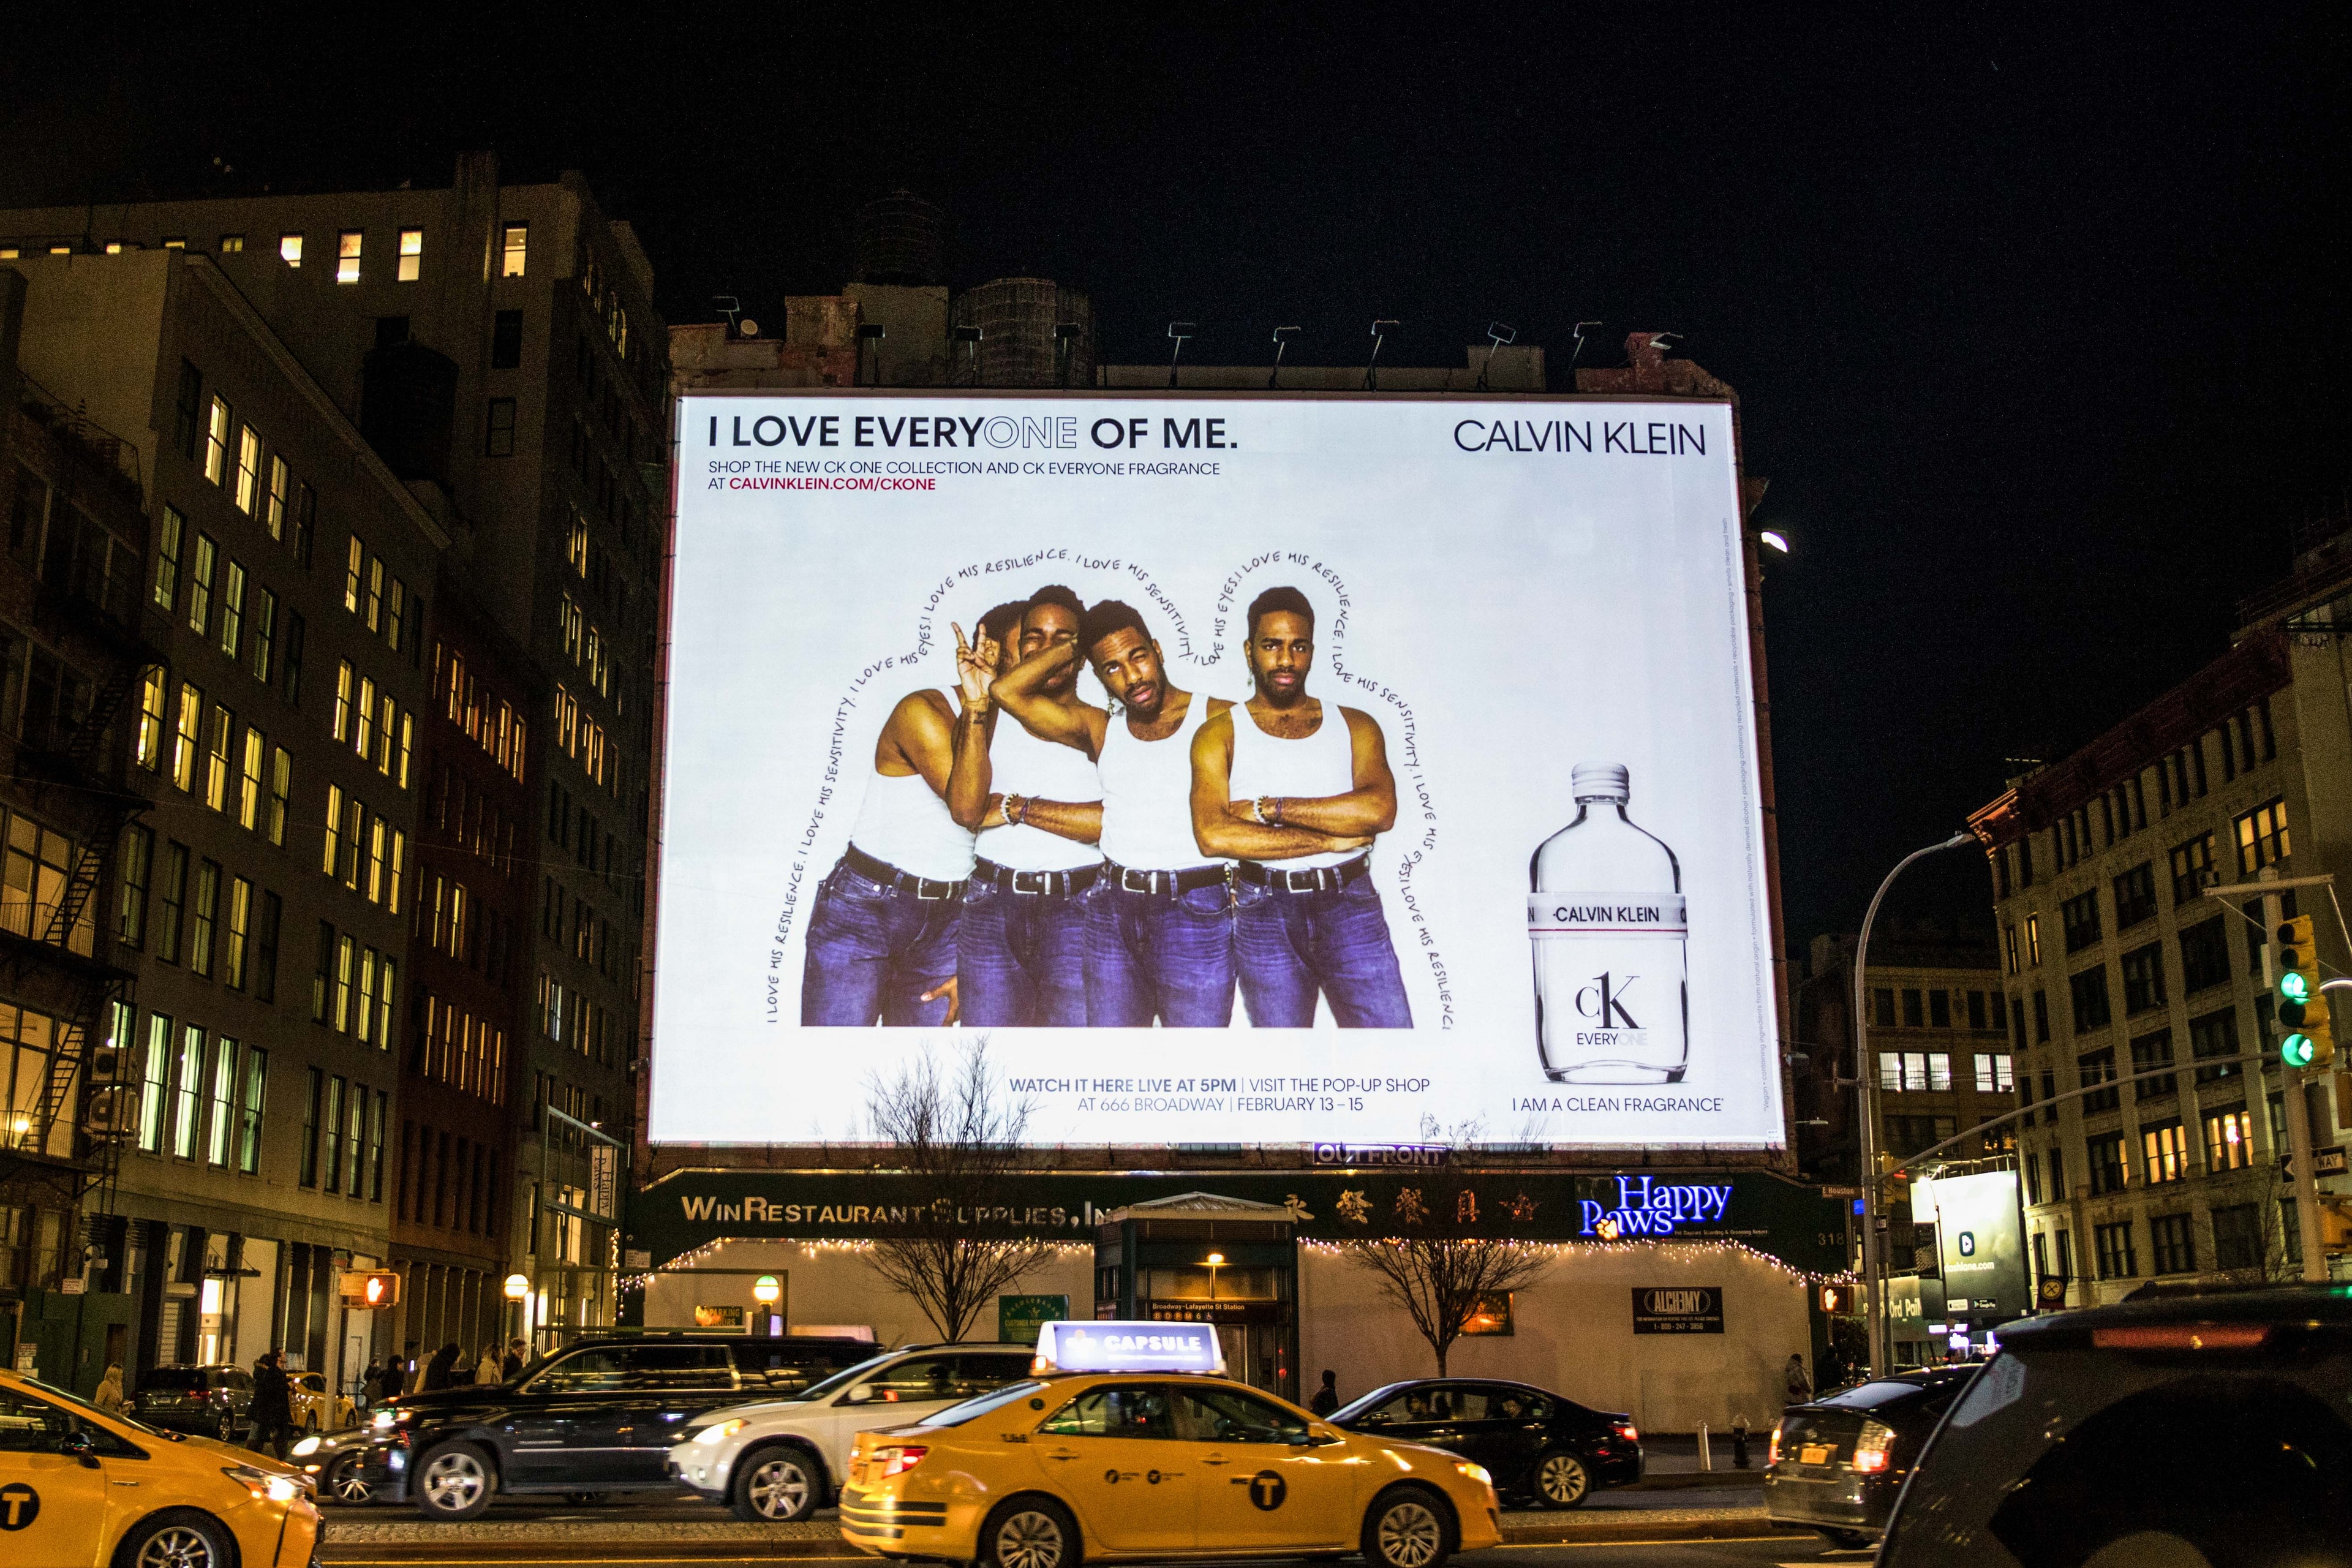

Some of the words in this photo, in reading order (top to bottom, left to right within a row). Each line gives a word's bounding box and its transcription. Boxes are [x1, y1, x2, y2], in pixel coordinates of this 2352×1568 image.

[709, 416, 717, 447] I
[733, 415, 840, 447] LOVE
[854, 416, 1077, 448] EVERYONE
[1090, 417, 1148, 449] OF
[1163, 418, 1238, 449] ME.
[1453, 419, 1593, 453] CALVIN
[1605, 421, 1706, 456] KLEIN
[709, 461, 751, 473] SHOP
[755, 461, 782, 473] THE
[786, 461, 820, 473] NEW
[824, 461, 846, 473] CK
[850, 461, 882, 474] ONE
[886, 461, 982, 475] COLLECTION
[986, 462, 1019, 475] AND
[1023, 462, 1045, 475] CK
[1049, 462, 1125, 475] EVERYONE
[1129, 462, 1220, 475] FRAGRANCE
[708, 477, 726, 489] AT
[729, 477, 936, 491] CALVINKLEIN.COM/CKONE
[1084, 559, 1121, 570] LOVE
[1242, 551, 1281, 573] LOVE
[1288, 552, 1310, 565] HIS
[958, 565, 978, 578] HIS
[1128, 564, 1149, 581] HIS
[924, 576, 954, 612] LOVE
[1728, 592, 1736, 625] packaging
[1215, 617, 1226, 636] HIS
[1201, 642, 1224, 666] LOVE
[1730, 627, 1739, 659] recyclable
[900, 652, 918, 665] HIS
[1332, 653, 1354, 683] LOVE
[856, 657, 893, 685] LOVE
[1357, 677, 1378, 692] HIS
[1737, 725, 1746, 758] containing
[1740, 760, 1748, 794] packaging
[818, 786, 833, 805] HIS
[1416, 783, 1436, 821] LOVE
[801, 809, 824, 846] LOVE
[1423, 827, 1436, 850] HIS
[1746, 853, 1755, 881] naturally
[1401, 886, 1425, 923] LOVE
[1555, 907, 1612, 922] CALVIN
[1617, 907, 1659, 922] KLEIN
[1418, 927, 1434, 947] HIS
[771, 949, 783, 969] HIS
[767, 974, 779, 1014] LOVE
[1427, 952, 1454, 1030] RESILIENC
[1757, 1005, 1766, 1042] ingredients
[1760, 1044, 1768, 1080] containing
[1009, 1078, 1070, 1093] WATCH
[1074, 1078, 1088, 1092] IT
[1092, 1078, 1134, 1092] HERE
[1138, 1078, 1172, 1092] LIVE
[1176, 1078, 1196, 1092] AT
[1199, 1078, 1237, 1092] 5PM
[1249, 1078, 1286, 1092] VISIT
[1289, 1078, 1319, 1092] THE
[1322, 1078, 1382, 1092] POP-UP
[1385, 1078, 1431, 1093] SHOP
[1077, 1098, 1096, 1112] AT
[1100, 1098, 1131, 1112] 666
[1134, 1097, 1225, 1112] BROADWAY
[1237, 1097, 1316, 1111] FEBRUARY
[1319, 1097, 1335, 1111] 13
[1348, 1097, 1364, 1111] 15
[1512, 1098, 1516, 1112] I
[1520, 1098, 1548, 1112] AM
[1551, 1098, 1563, 1112] A
[1566, 1098, 1619, 1112] CLEAN
[1614, 1175, 1734, 1223] Happy
[1577, 1199, 1675, 1236] Paws
[1944, 1262, 1995, 1273] dashlane.com
[709, 1308, 741, 1317] PARKING
[1103, 1335, 1202, 1351] CAPSULE
[1257, 1478, 1280, 1506] T
[2, 1493, 31, 1525] T
